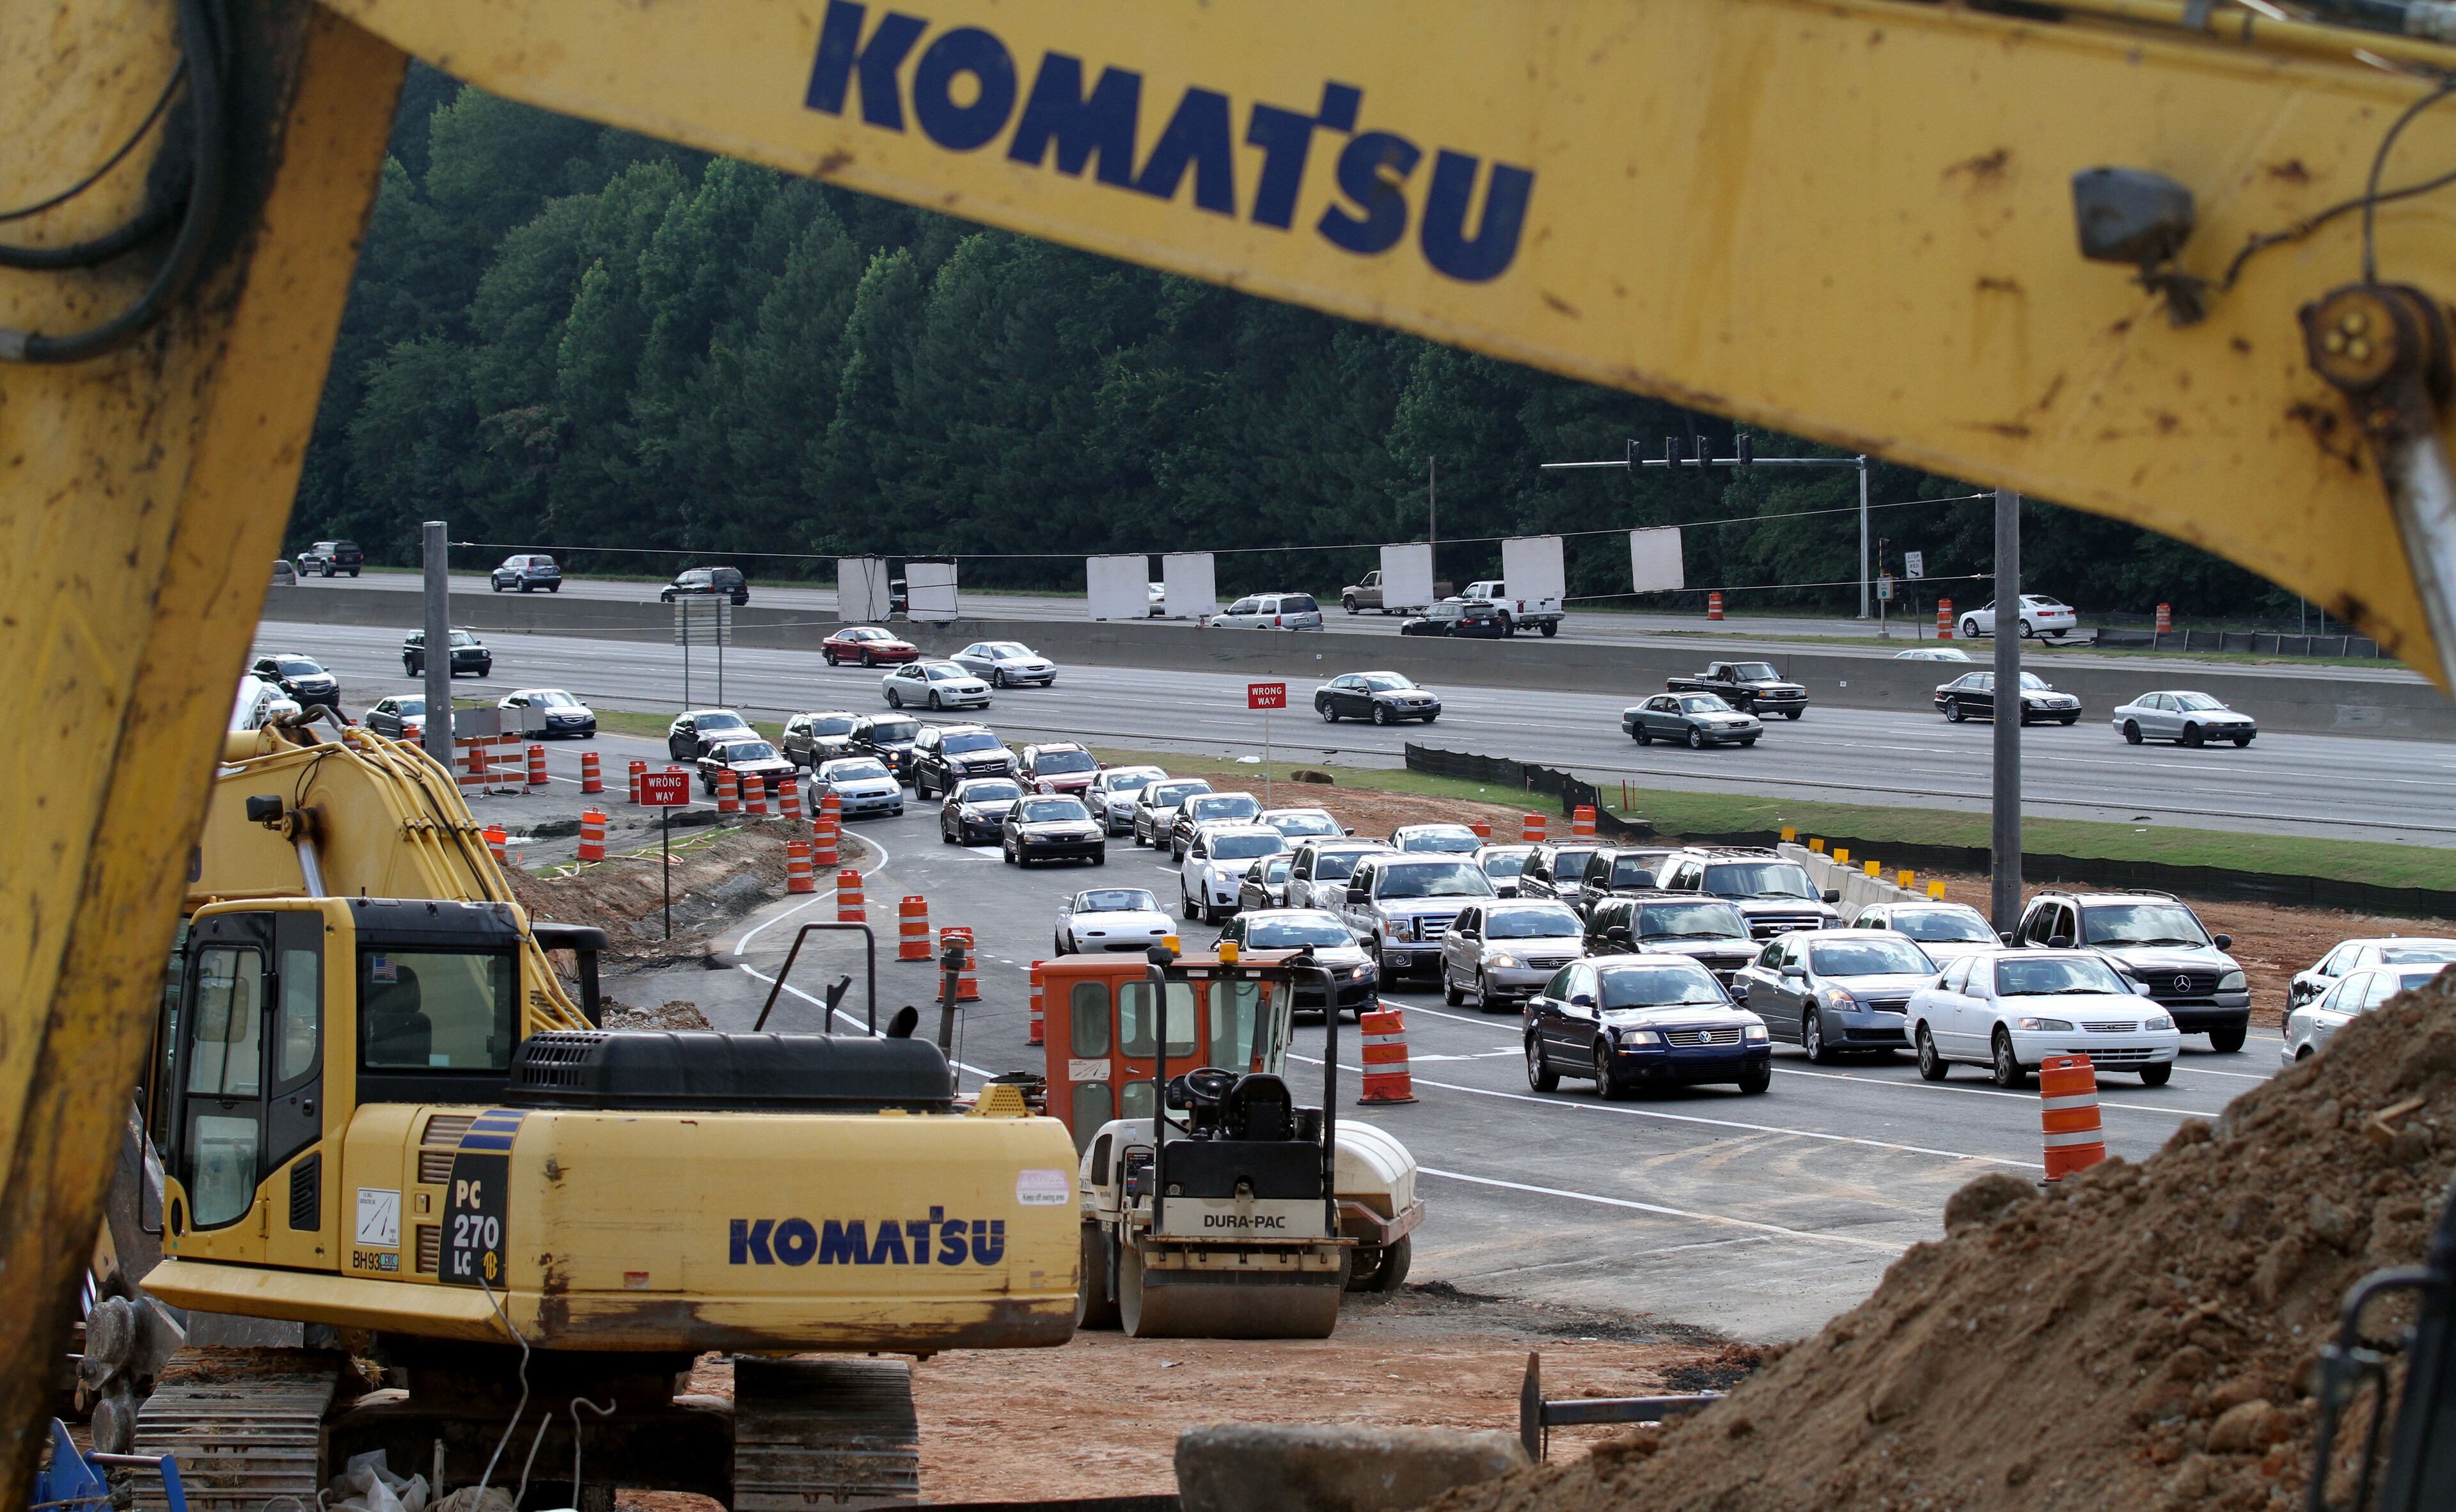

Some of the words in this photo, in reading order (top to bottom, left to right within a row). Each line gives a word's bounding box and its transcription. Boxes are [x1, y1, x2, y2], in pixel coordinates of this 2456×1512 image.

[803, 0, 1536, 284] KOMATSU
[1252, 687, 1282, 695] WRONG
[1257, 697, 1276, 705] WAY
[649, 777, 681, 787] WRONG
[656, 792, 674, 801] WAY
[456, 1180, 481, 1209] PC
[1204, 1215, 1286, 1228] DURA-PAC
[453, 1214, 500, 1249] 270
[729, 1206, 1005, 1266] KOMATSU
[454, 1250, 471, 1275] LC
